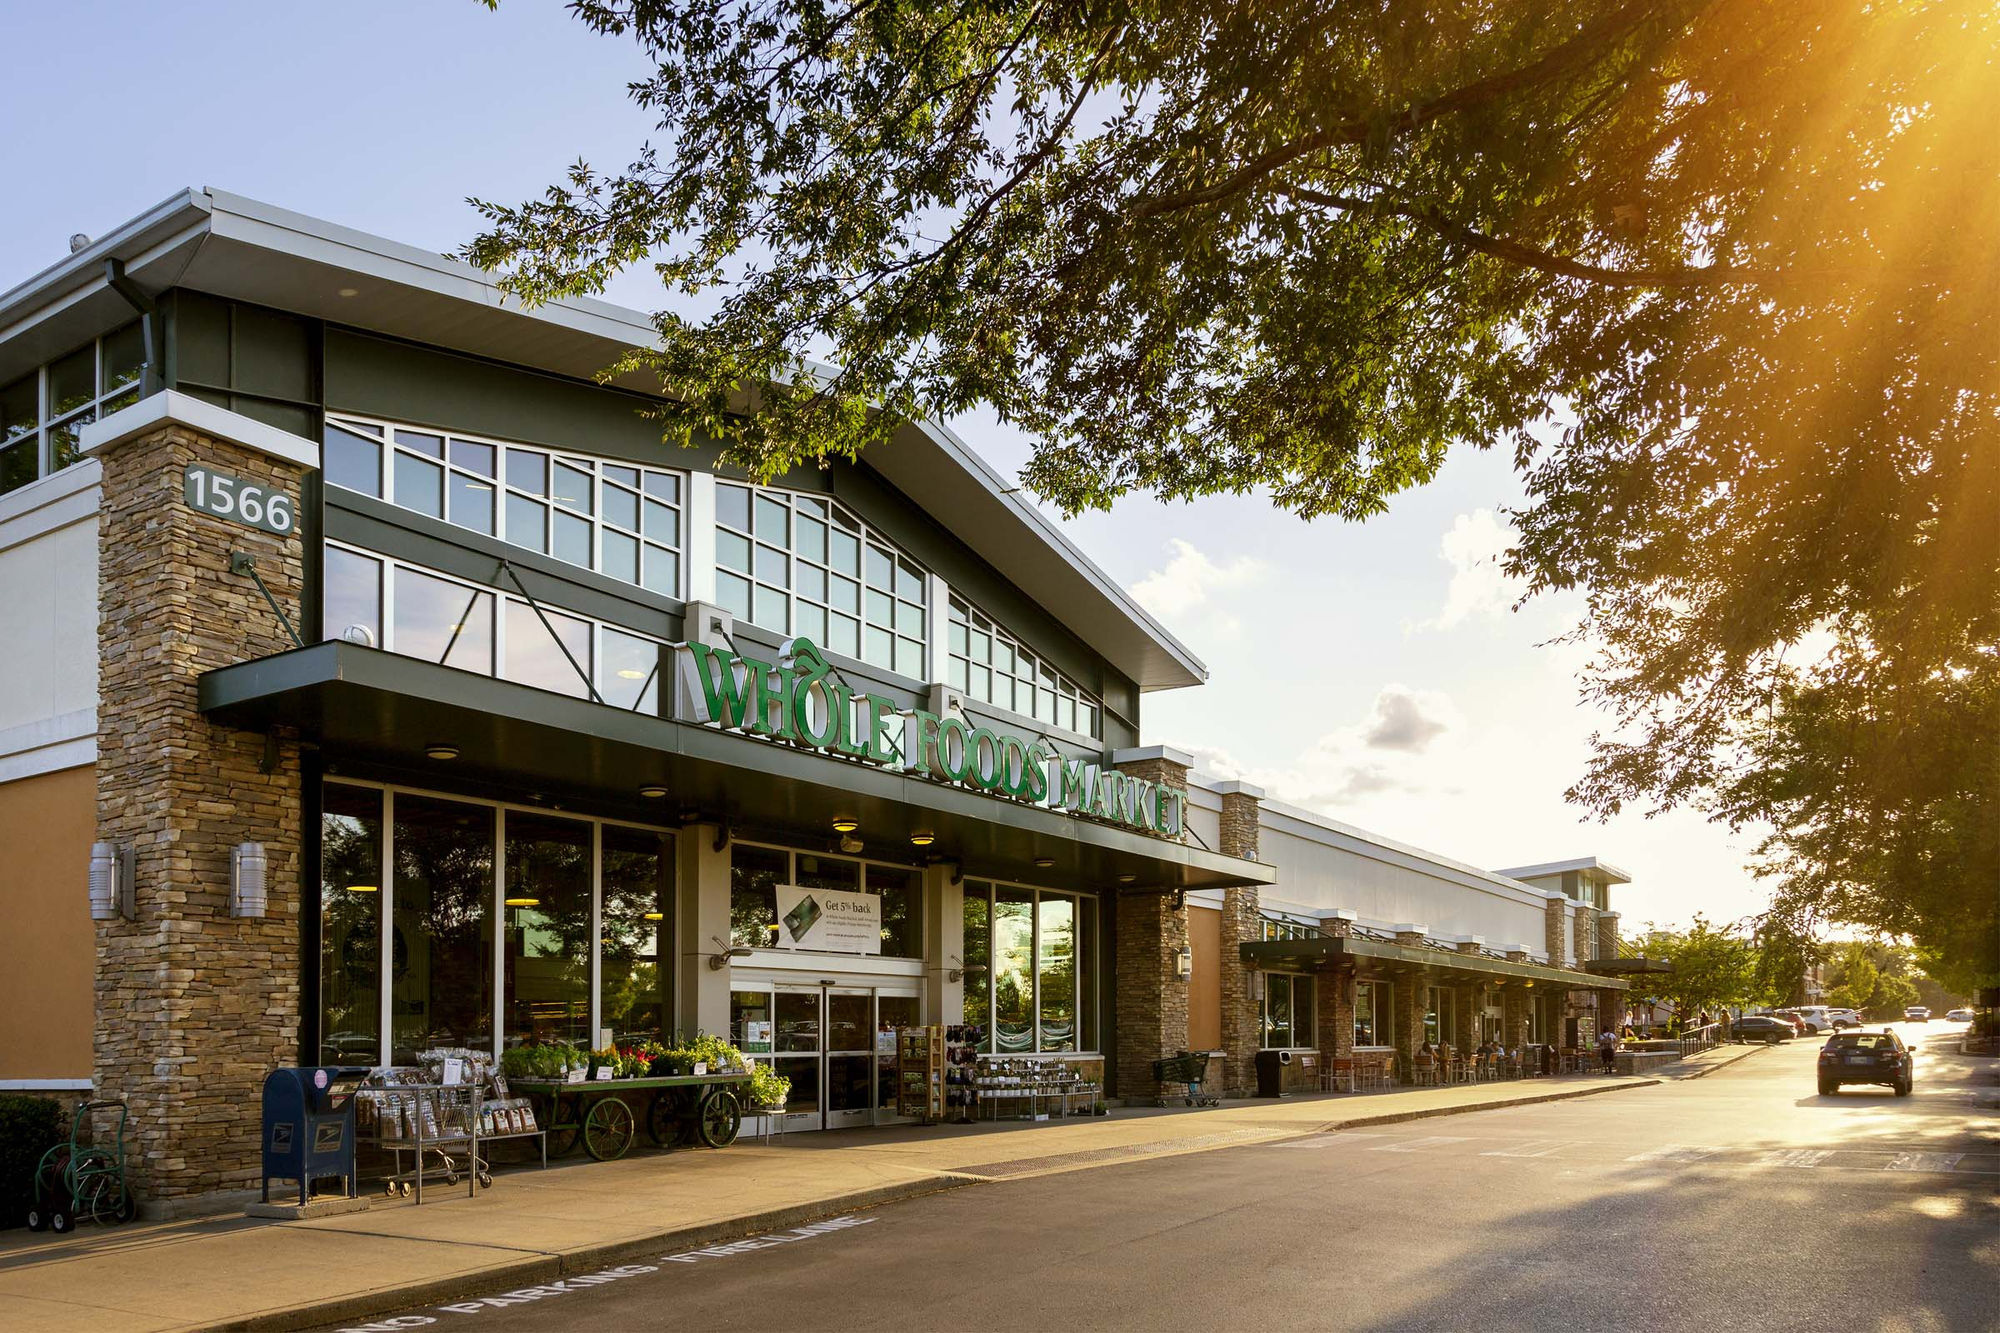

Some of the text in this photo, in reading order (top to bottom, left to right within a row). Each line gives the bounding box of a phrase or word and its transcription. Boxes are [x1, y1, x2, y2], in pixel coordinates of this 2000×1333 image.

[188, 470, 291, 530] 1566
[682, 637, 1189, 837] WHOLE FOODS MARKET
[825, 899, 872, 914] Get 5% back
[437, 1264, 660, 1314] PARKING
[660, 1239, 783, 1263] FIRE
[758, 1215, 880, 1243] LANE
